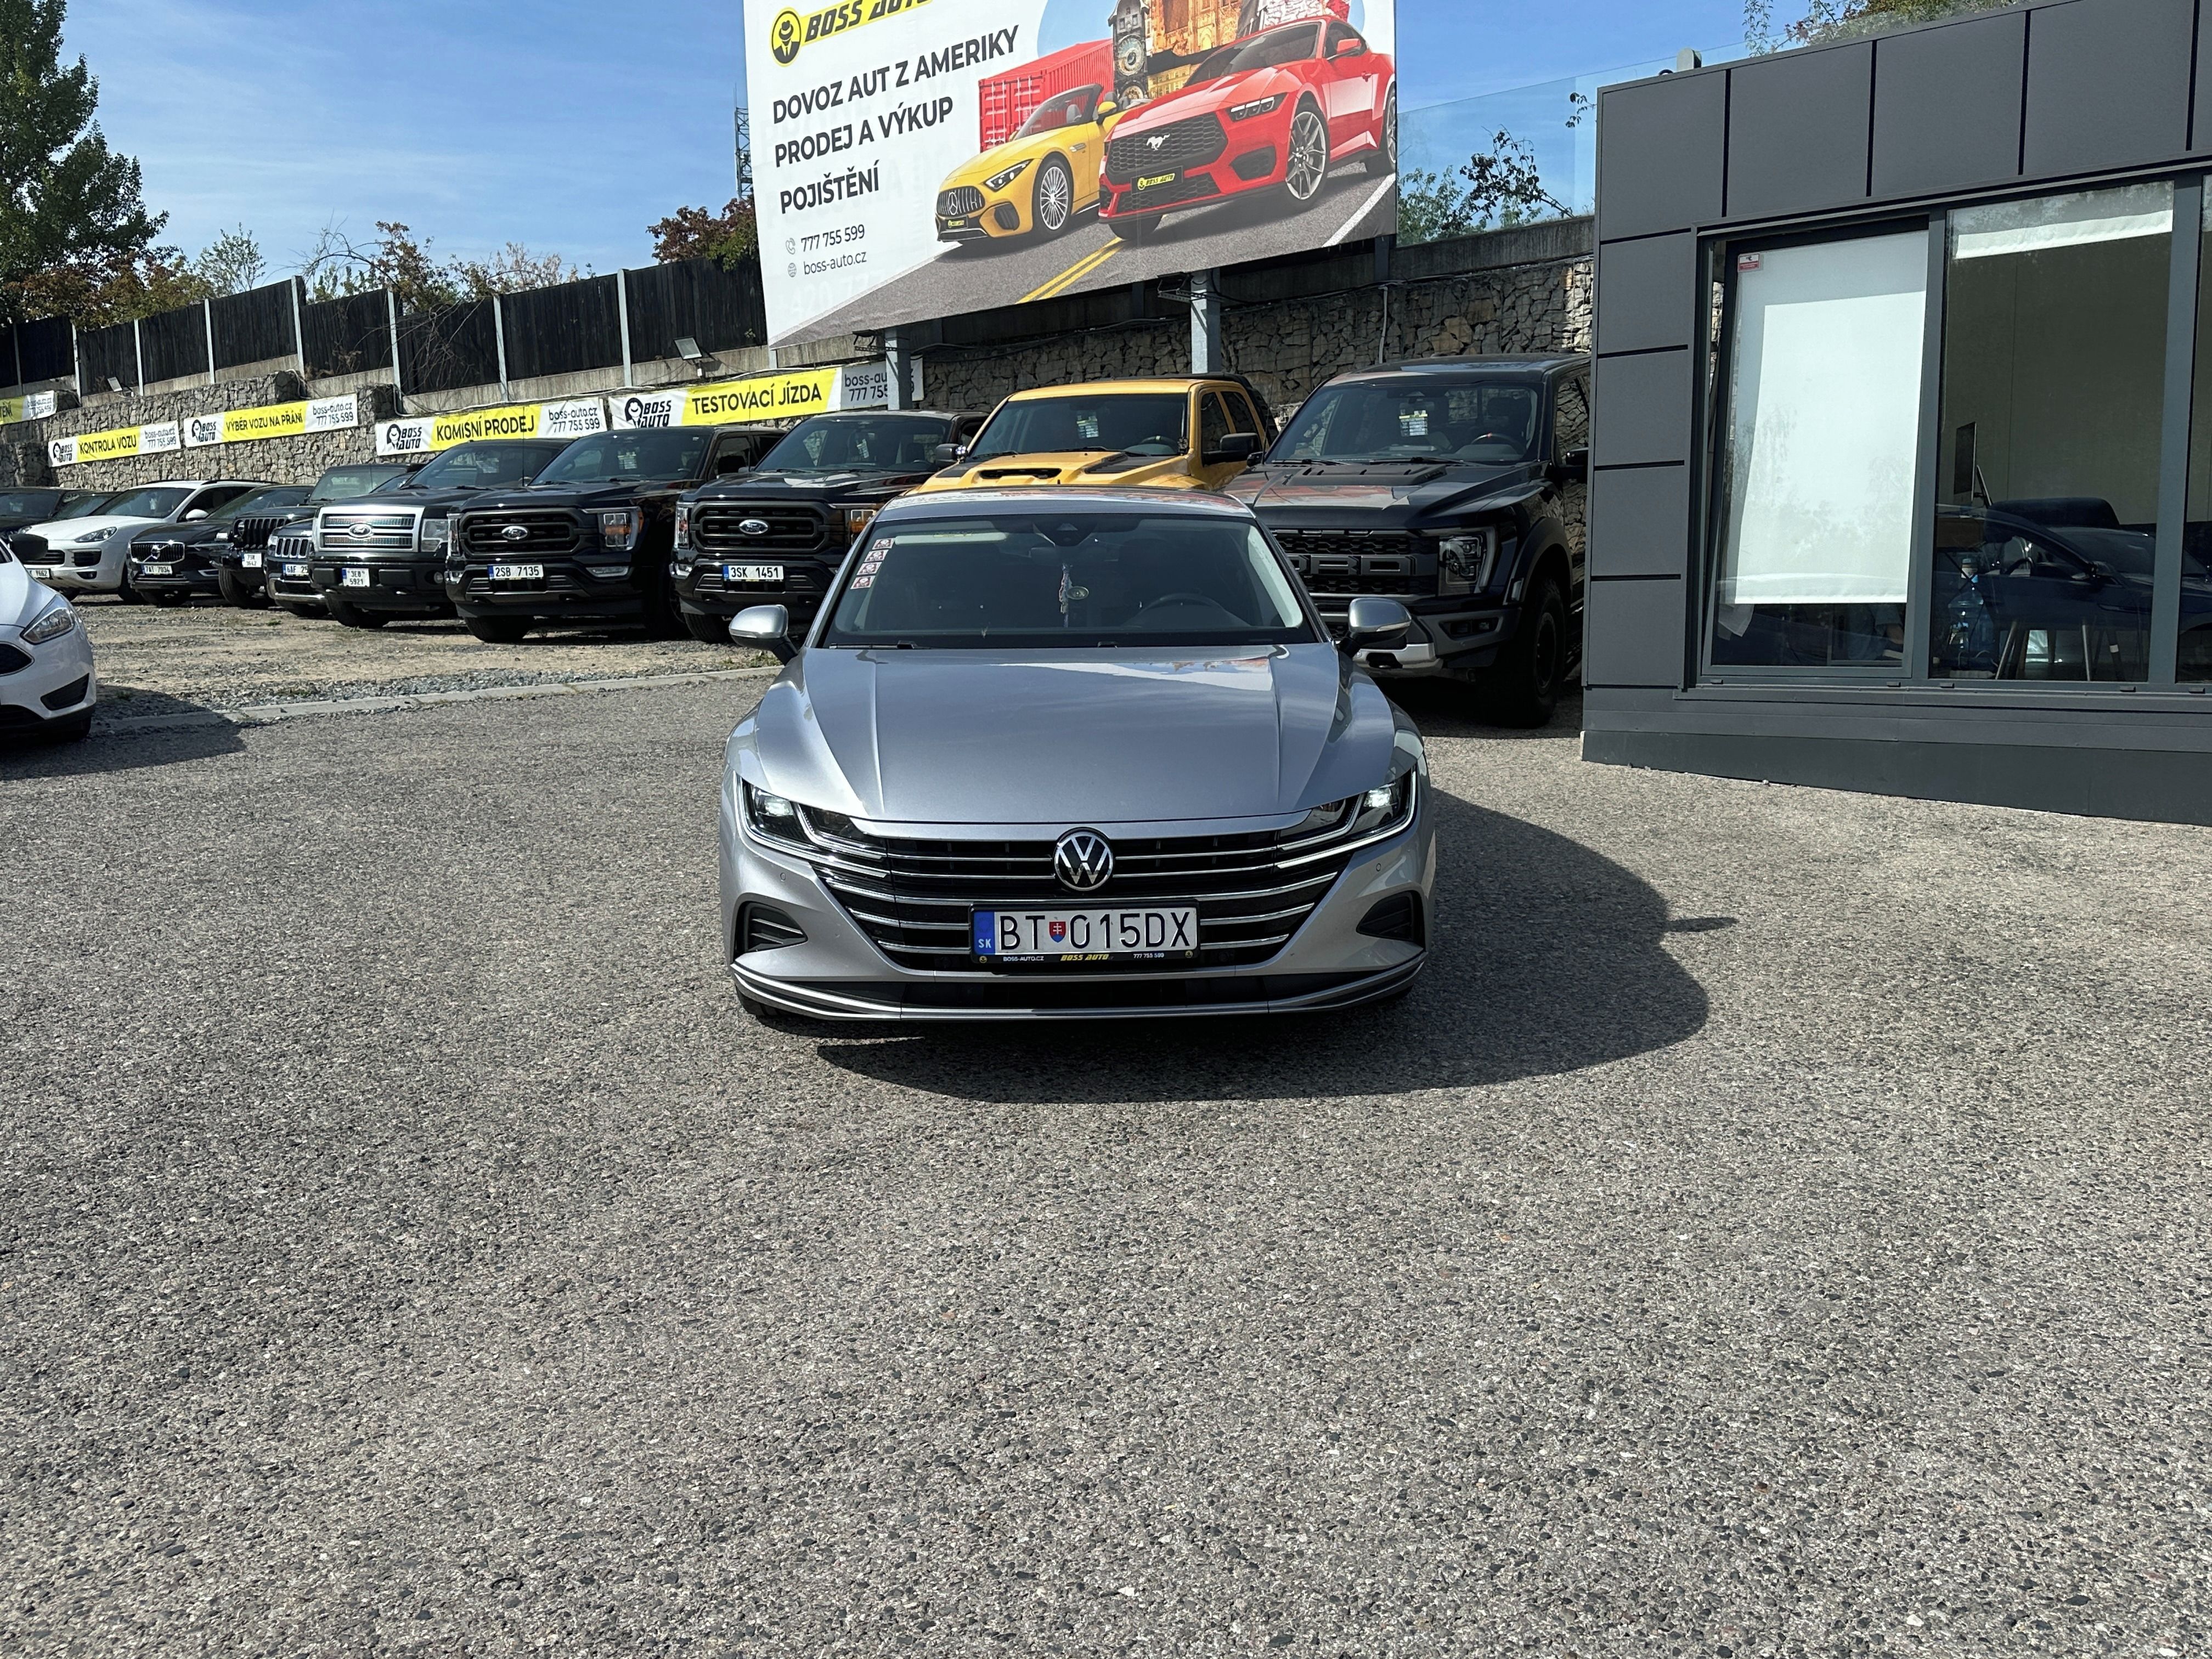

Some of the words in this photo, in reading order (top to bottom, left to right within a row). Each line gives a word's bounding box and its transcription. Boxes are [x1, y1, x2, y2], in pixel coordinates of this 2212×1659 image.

[804, 0, 862, 42] BOSS
[868, 0, 927, 20] AU
[773, 81, 843, 124] DOVOZ
[848, 66, 890, 102] AUT
[895, 60, 910, 87] Z
[914, 24, 1019, 82] AMERIKY
[775, 124, 853, 167] PRODEJ
[859, 120, 874, 145] A
[878, 97, 953, 138] VÝKUP
[780, 159, 879, 214] POJIŠTĚNÍ
[801, 234, 820, 252] 777
[822, 229, 842, 247] 755
[844, 224, 865, 242] 599
[803, 251, 867, 275] boss-auto.cz
[844, 371, 887, 387] boss-au
[692, 382, 775, 415] TESTOVACÍ
[778, 380, 822, 405] JÍZDA
[849, 387, 867, 402] 777
[313, 402, 352, 415] boss-auto.cz
[549, 407, 598, 421] boss-auto.cz
[644, 400, 672, 415] BOSS
[226, 417, 247, 432] VÝBĚR
[249, 417, 268, 430] VOZU
[269, 415, 280, 427] NA
[281, 409, 303, 426] PŘÁNÍ
[316, 415, 327, 426] 777
[329, 414, 340, 424] 755
[341, 411, 354, 422] 599
[553, 421, 566, 433] 777
[568, 419, 583, 431] 755
[585, 417, 600, 430] 599
[640, 414, 670, 428] AUTO
[202, 421, 216, 432] BOSS
[401, 427, 422, 438] BOSS
[437, 415, 482, 441] KOMISNÍ
[484, 415, 534, 436] PRODEJ
[200, 431, 215, 442] AUTO
[397, 438, 421, 450] AUTO
[79, 438, 116, 455] KONTROLA
[117, 435, 137, 449] VOZU
[495, 567, 511, 577] 2SB
[517, 566, 539, 577] 7135
[731, 567, 748, 578] 3SK
[755, 567, 778, 578] 1451
[1000, 912, 1046, 950] BT
[1070, 911, 1190, 949] 015DX
[978, 938, 992, 949] SK
